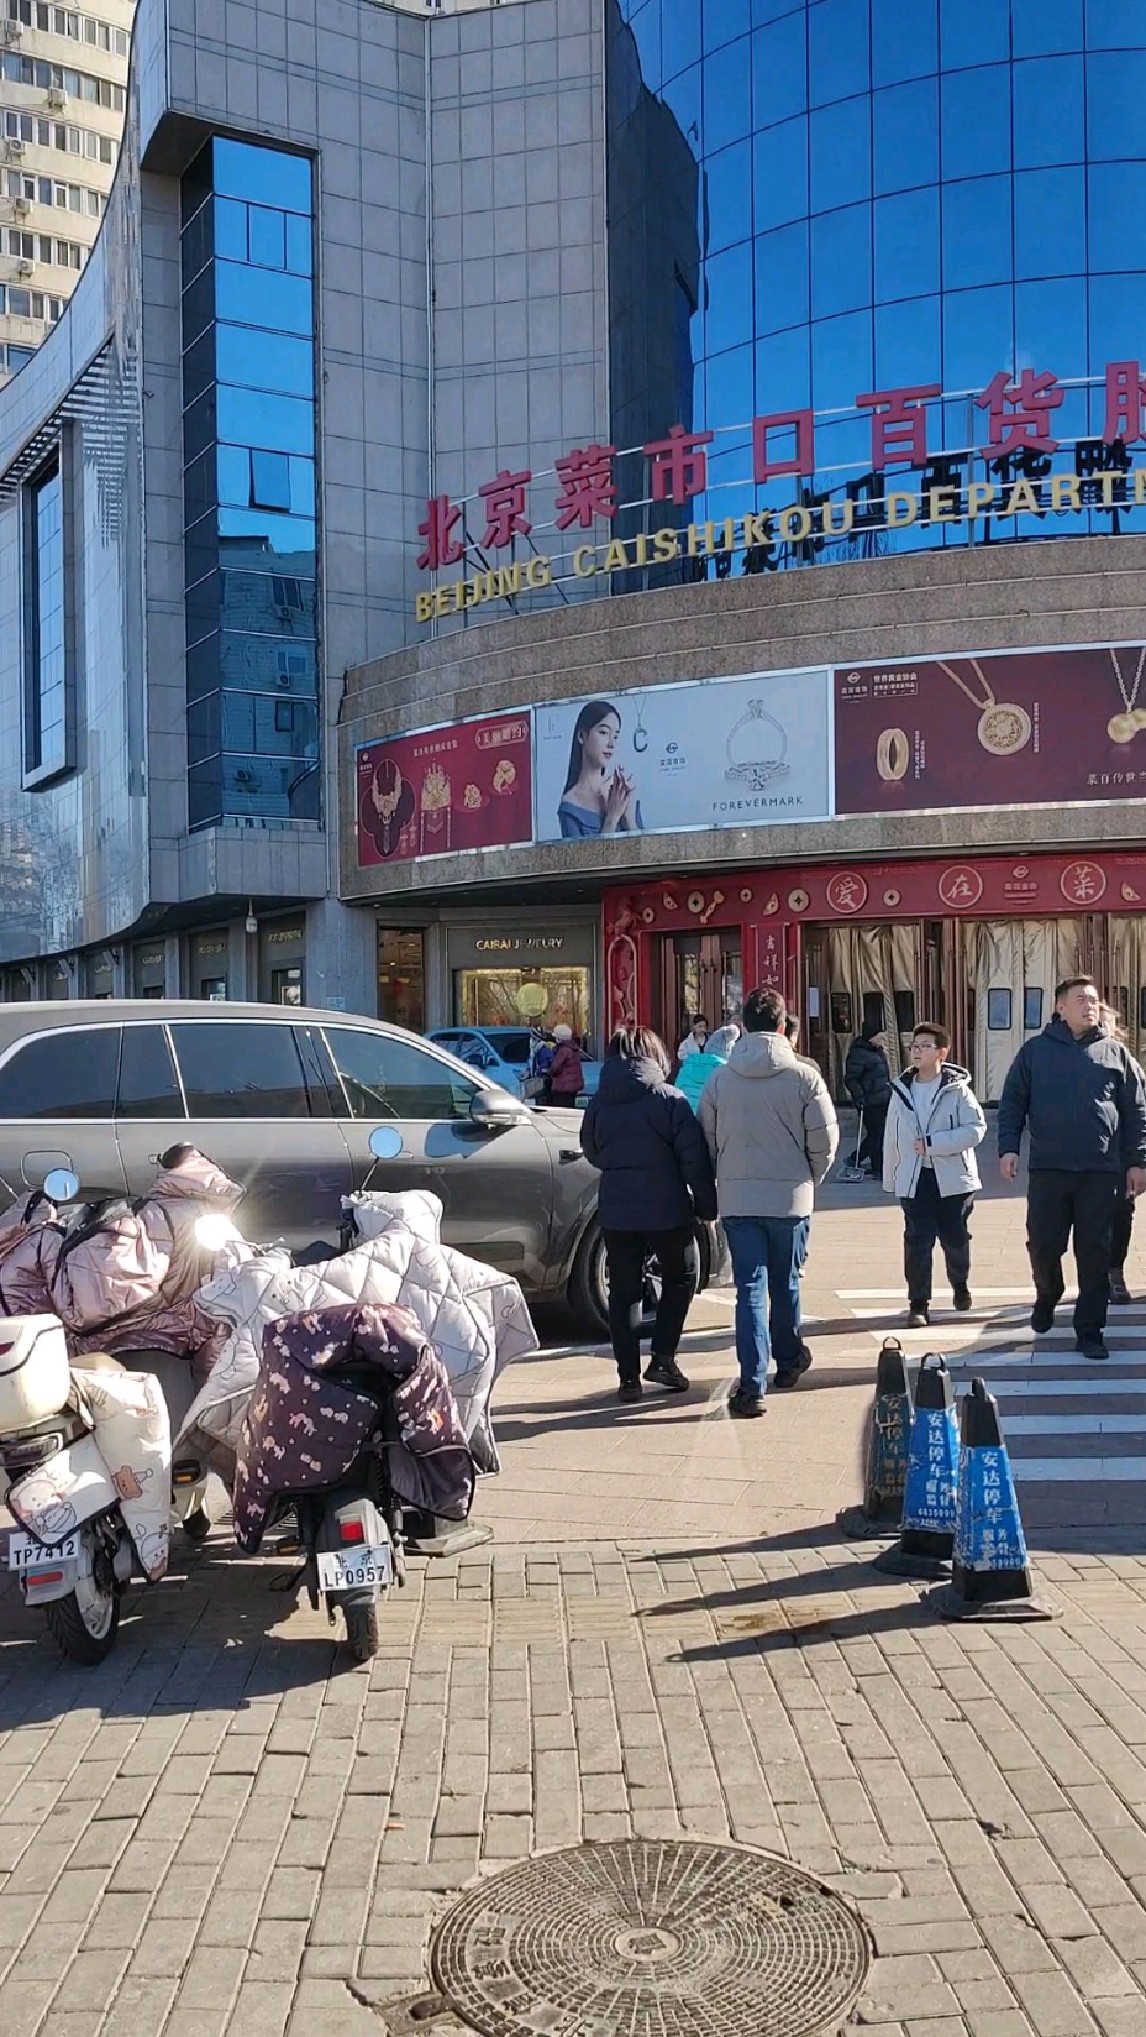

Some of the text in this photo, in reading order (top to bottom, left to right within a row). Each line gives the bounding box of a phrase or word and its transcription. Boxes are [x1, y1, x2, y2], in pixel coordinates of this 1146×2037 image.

[416, 555, 552, 622] BEIJING
[573, 499, 854, 579] CAISHIKOU
[713, 796, 803, 811] FOREVERMARK
[947, 873, 973, 899] 在
[1073, 865, 1096, 900] 菜
[926, 1412, 947, 1478] 安达停车
[982, 1451, 1003, 1524] 安达停车
[14, 1540, 75, 1566] TP7412
[324, 1565, 385, 1587] LP0957
